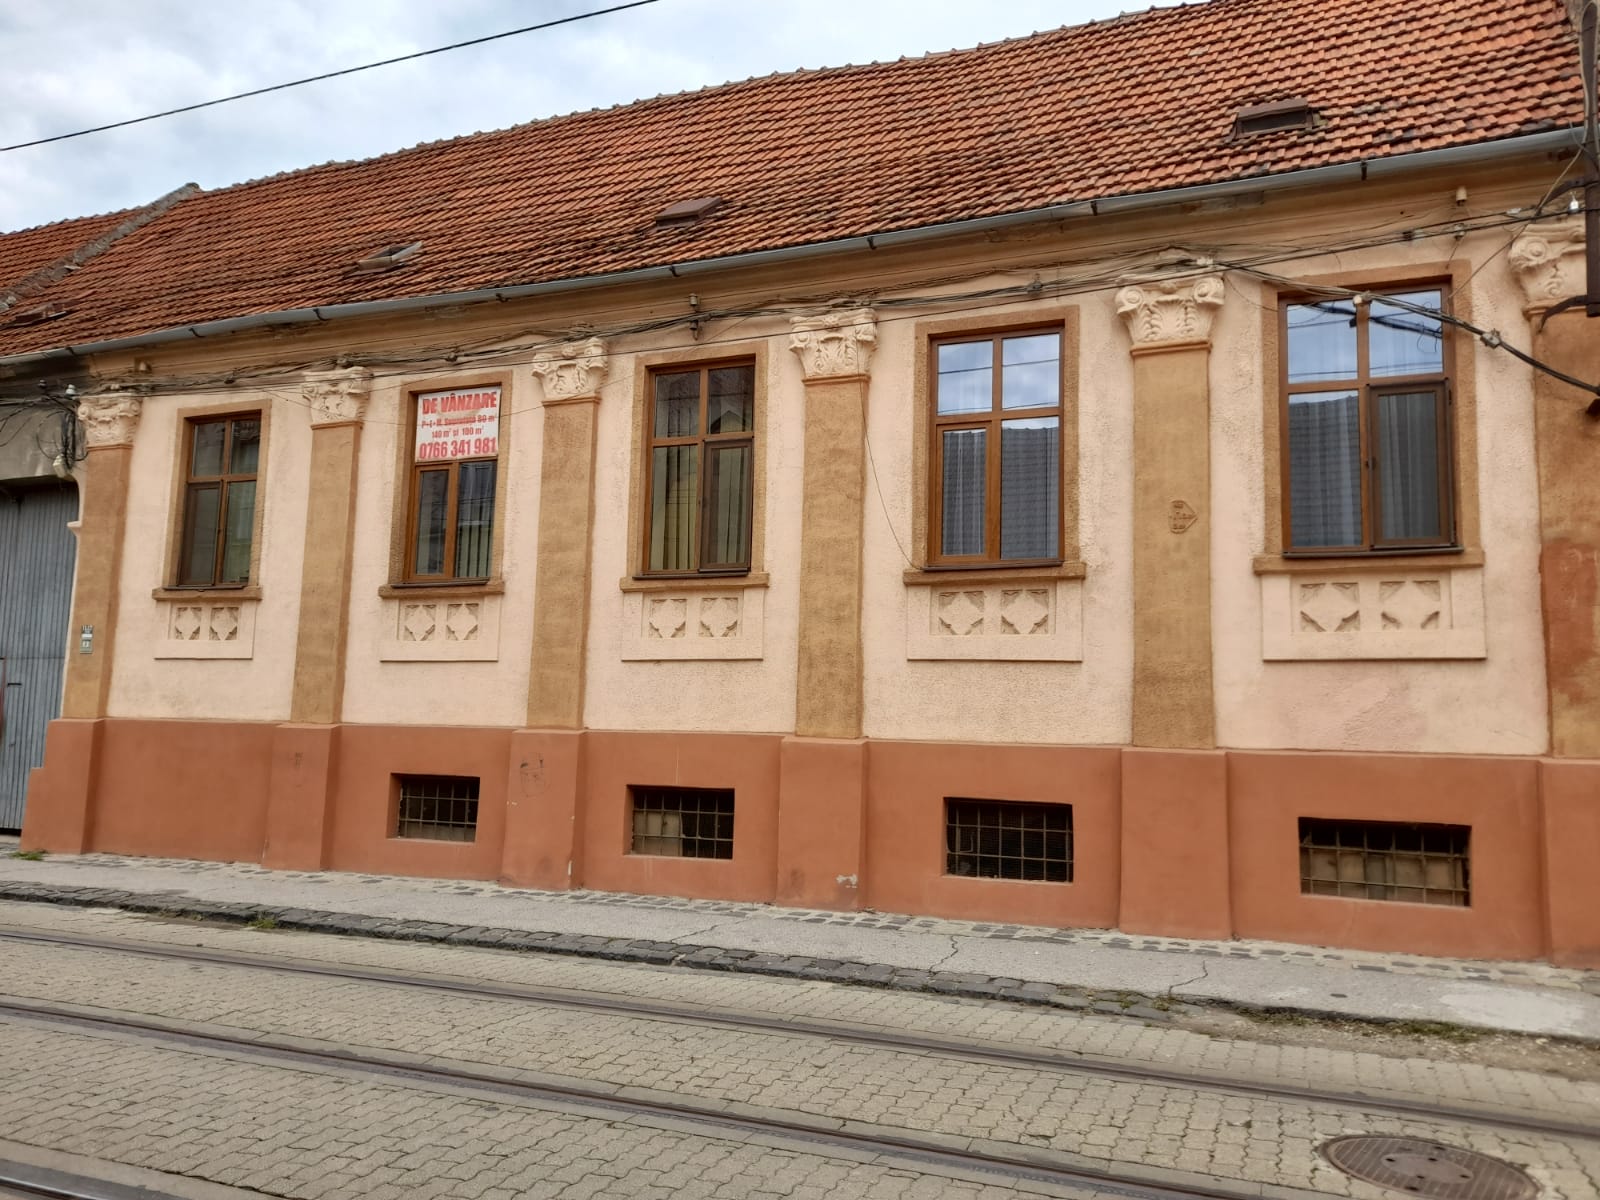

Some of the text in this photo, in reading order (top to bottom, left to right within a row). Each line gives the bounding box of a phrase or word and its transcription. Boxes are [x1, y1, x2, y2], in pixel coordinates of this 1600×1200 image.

[422, 391, 497, 415] DE VÂNZARE
[420, 437, 497, 459] 0766 341 981
